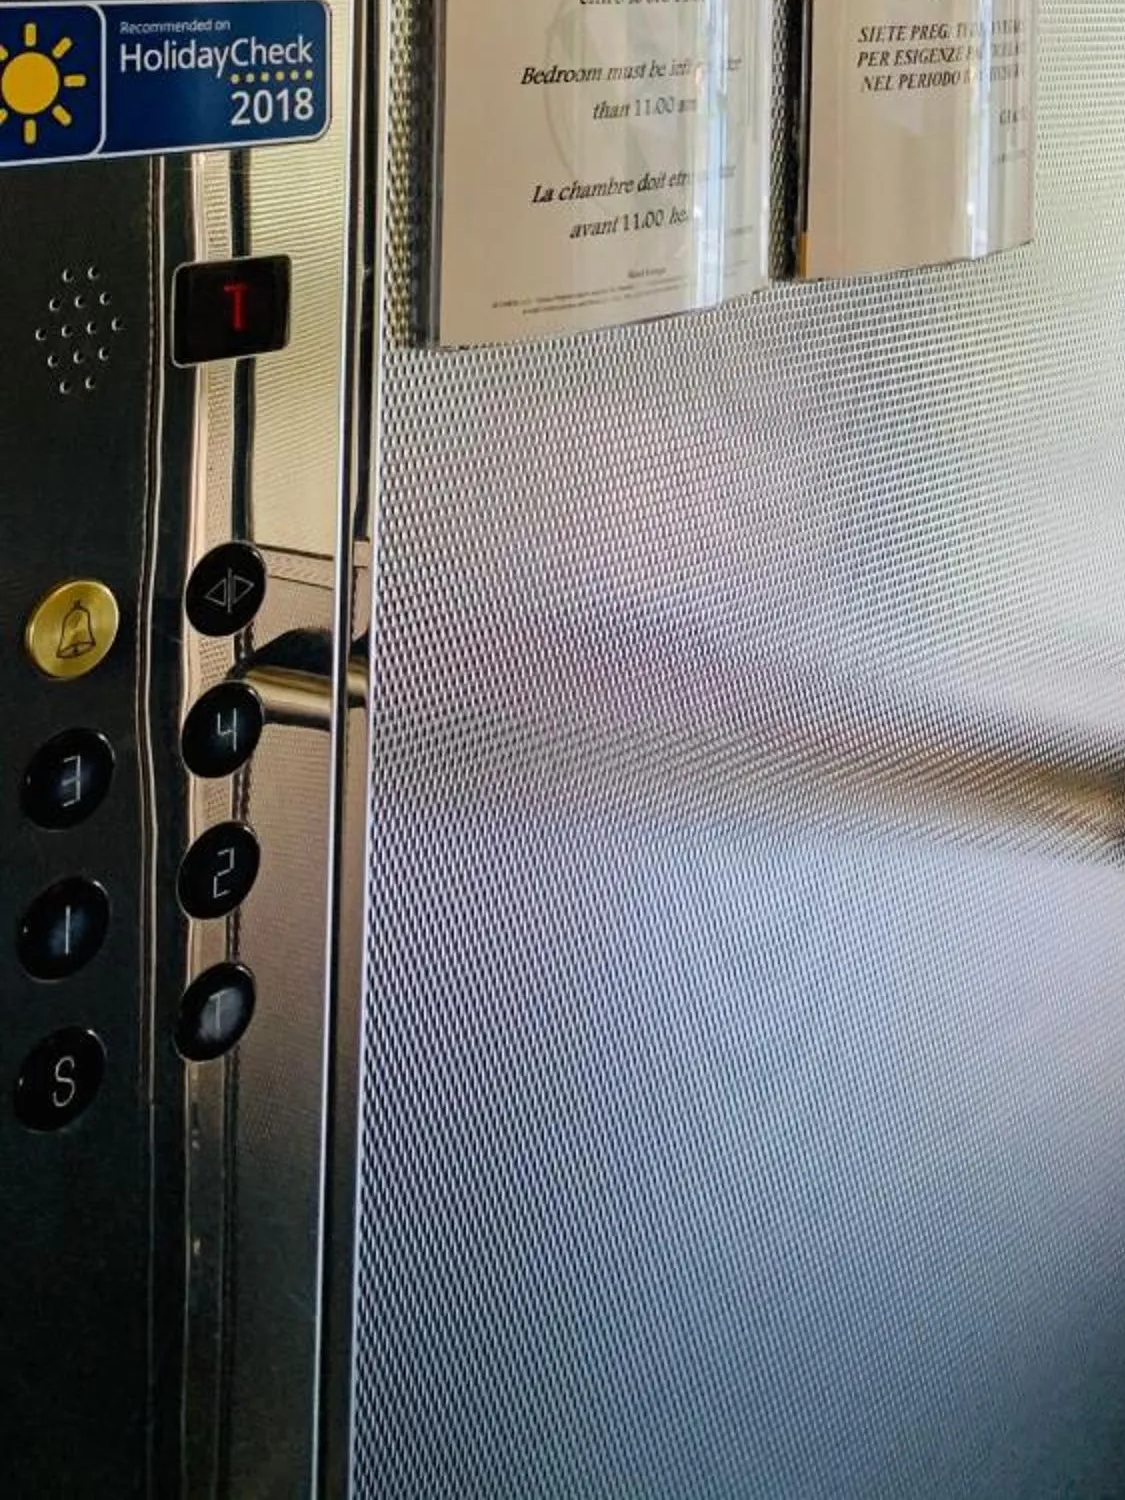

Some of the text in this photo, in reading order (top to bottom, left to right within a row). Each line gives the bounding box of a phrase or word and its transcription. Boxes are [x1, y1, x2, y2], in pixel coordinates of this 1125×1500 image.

[119, 19, 231, 34] Recommended on
[858, 25, 906, 43] SIETE
[119, 36, 314, 78] HolidayCheck
[857, 51, 889, 68] PER
[893, 47, 963, 66] ESIGENZE
[521, 65, 602, 85] Bedroom
[607, 61, 647, 81] must
[649, 59, 666, 78] be
[861, 75, 893, 93] NEL
[899, 69, 961, 90] PERIODO
[230, 87, 314, 126] 2018
[592, 101, 630, 119] than
[532, 185, 553, 203] La
[558, 177, 635, 200] chambre
[638, 171, 666, 192] doit
[570, 217, 618, 238] avant
[216, 707, 238, 753] 4
[62, 754, 82, 808] 3
[213, 847, 235, 899] 2
[52, 1056, 76, 1108] S
